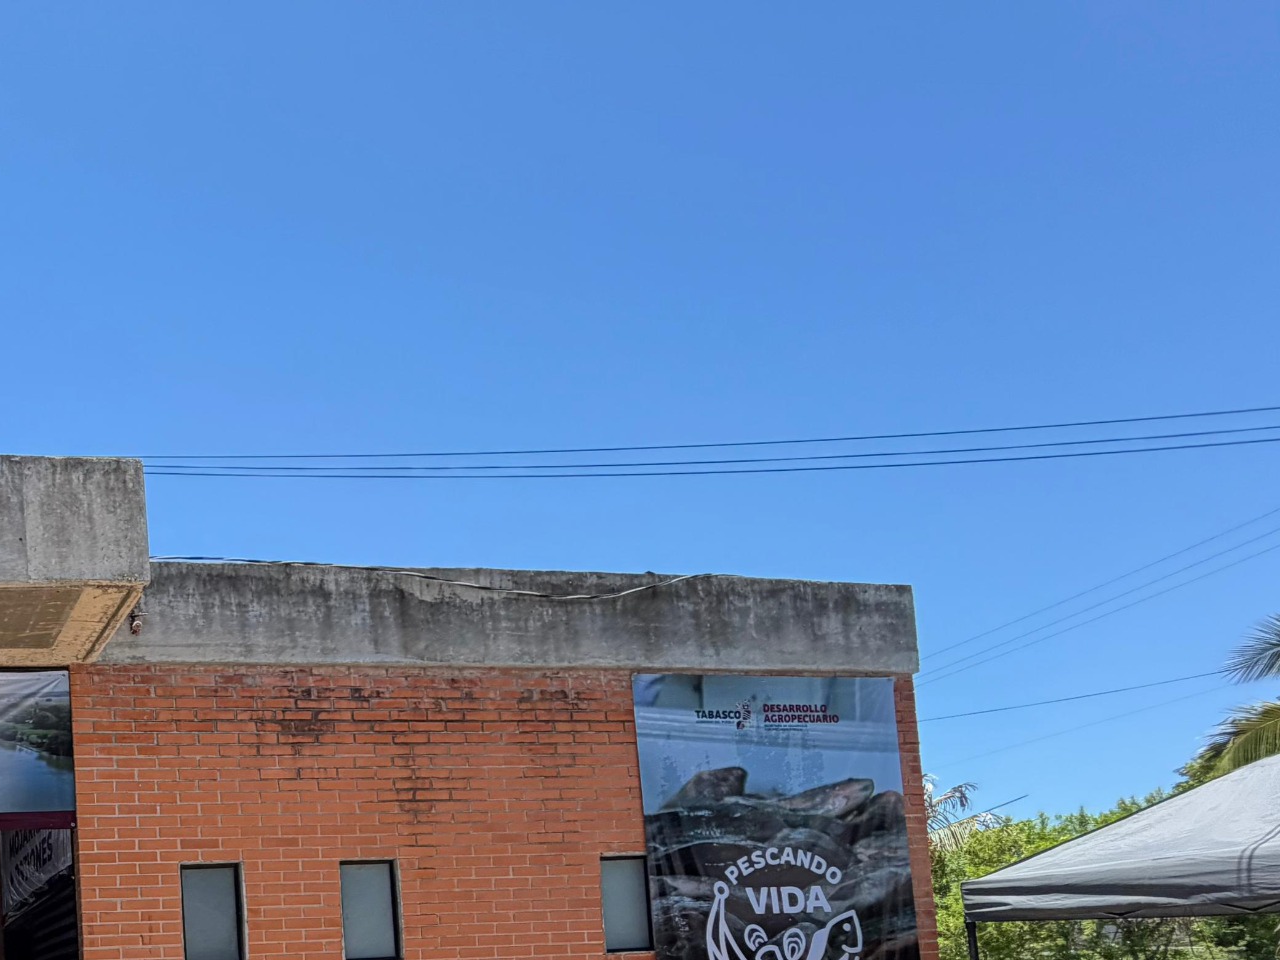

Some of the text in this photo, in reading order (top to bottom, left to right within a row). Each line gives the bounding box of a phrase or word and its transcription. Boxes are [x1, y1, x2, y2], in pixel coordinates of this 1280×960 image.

[763, 703, 827, 713] DESARROLLO
[695, 710, 741, 720] TABASCO
[763, 714, 839, 724] AGROPECUARIO
[724, 846, 842, 886] PESCANDO
[745, 885, 832, 914] VIDA
